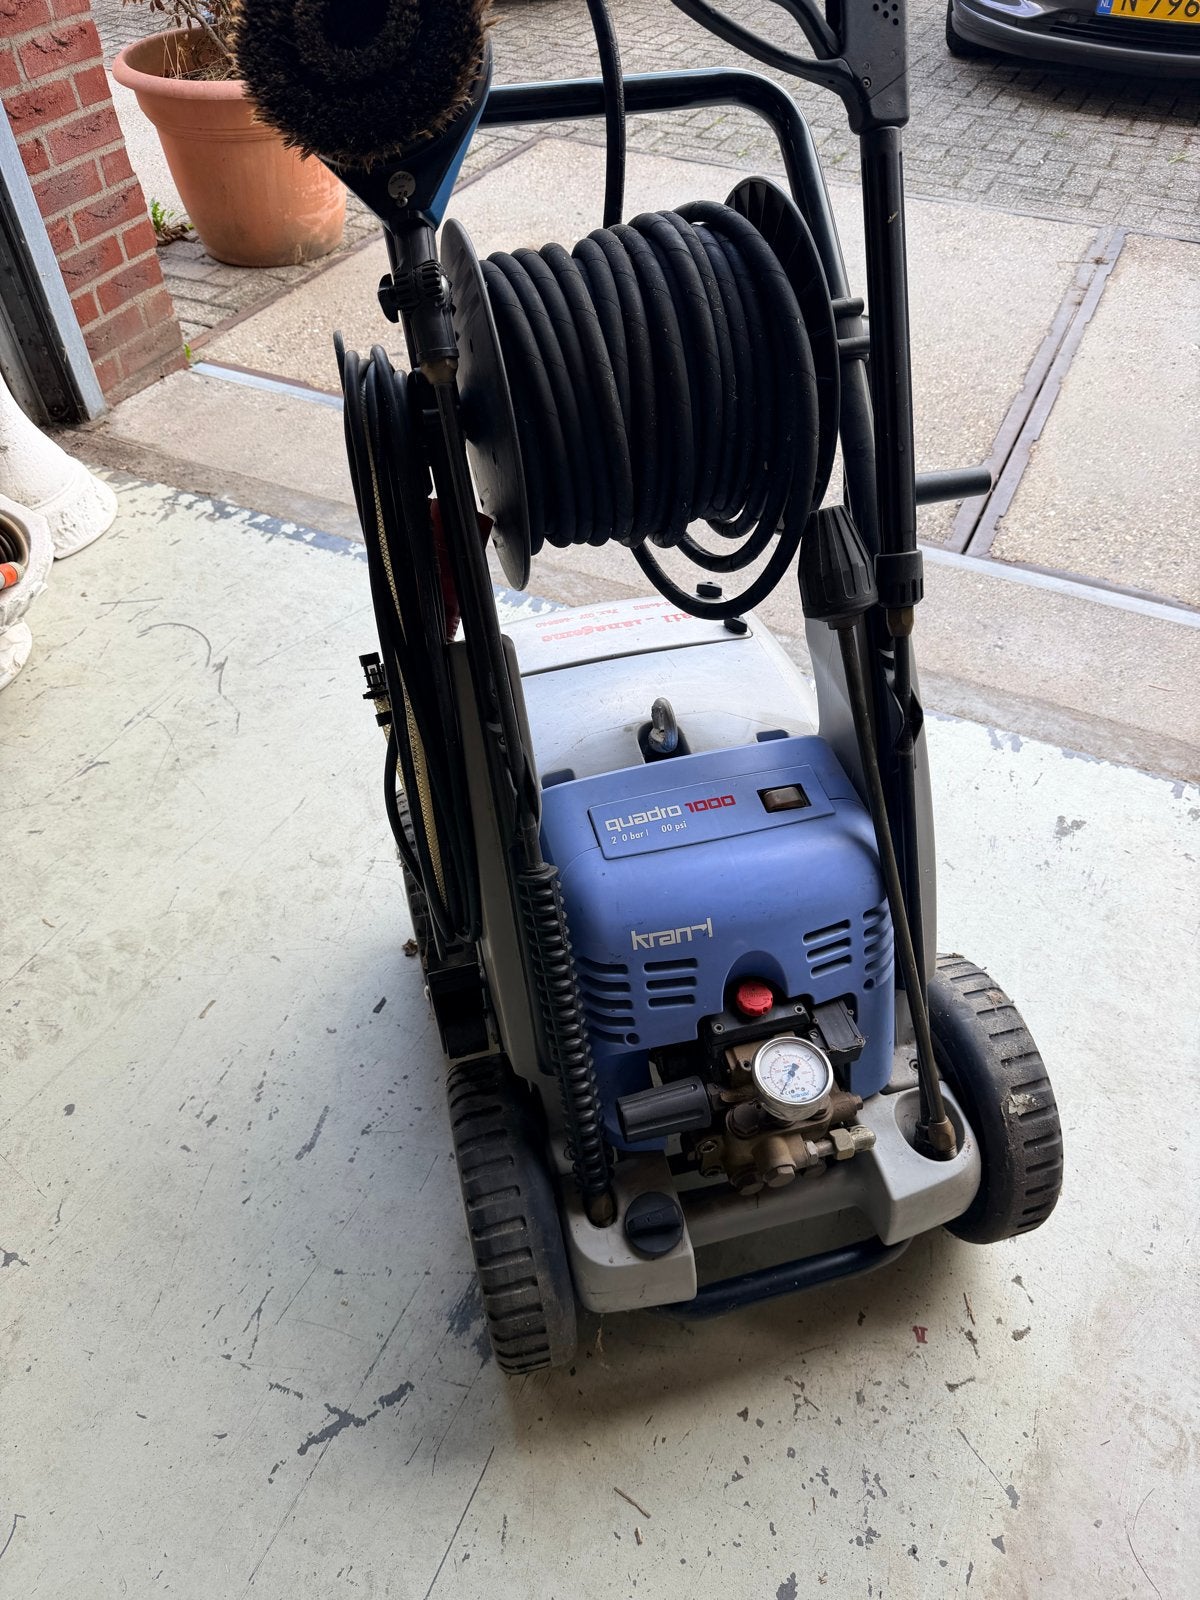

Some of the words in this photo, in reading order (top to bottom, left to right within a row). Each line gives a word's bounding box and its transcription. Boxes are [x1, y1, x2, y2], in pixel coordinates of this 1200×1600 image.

[604, 805, 682, 832] quadro
[684, 795, 737, 813] 1000
[630, 830, 643, 840] bar
[675, 820, 687, 832] psi
